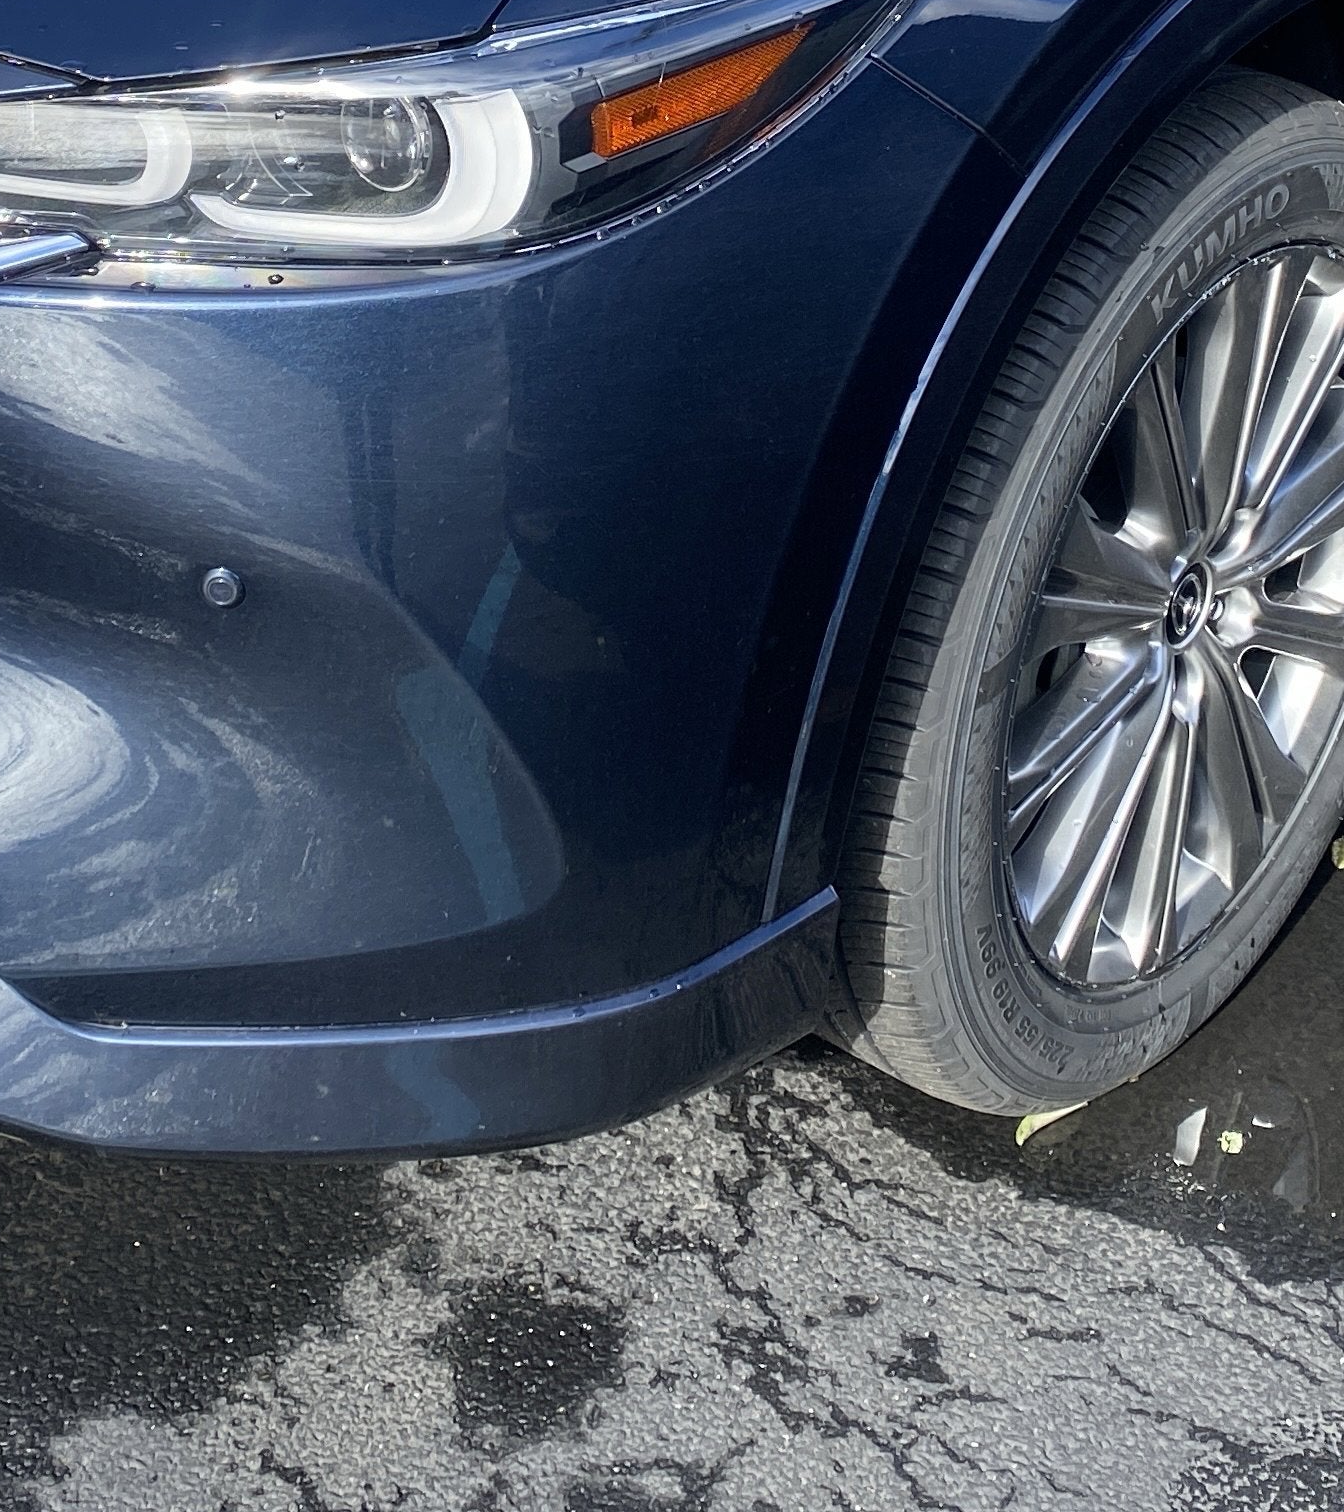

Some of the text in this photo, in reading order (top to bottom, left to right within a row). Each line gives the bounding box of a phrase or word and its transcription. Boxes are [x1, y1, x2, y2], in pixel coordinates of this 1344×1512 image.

[1150, 183, 1290, 326] KUMHO
[975, 923, 1076, 1075] 225/55 R19 99V
